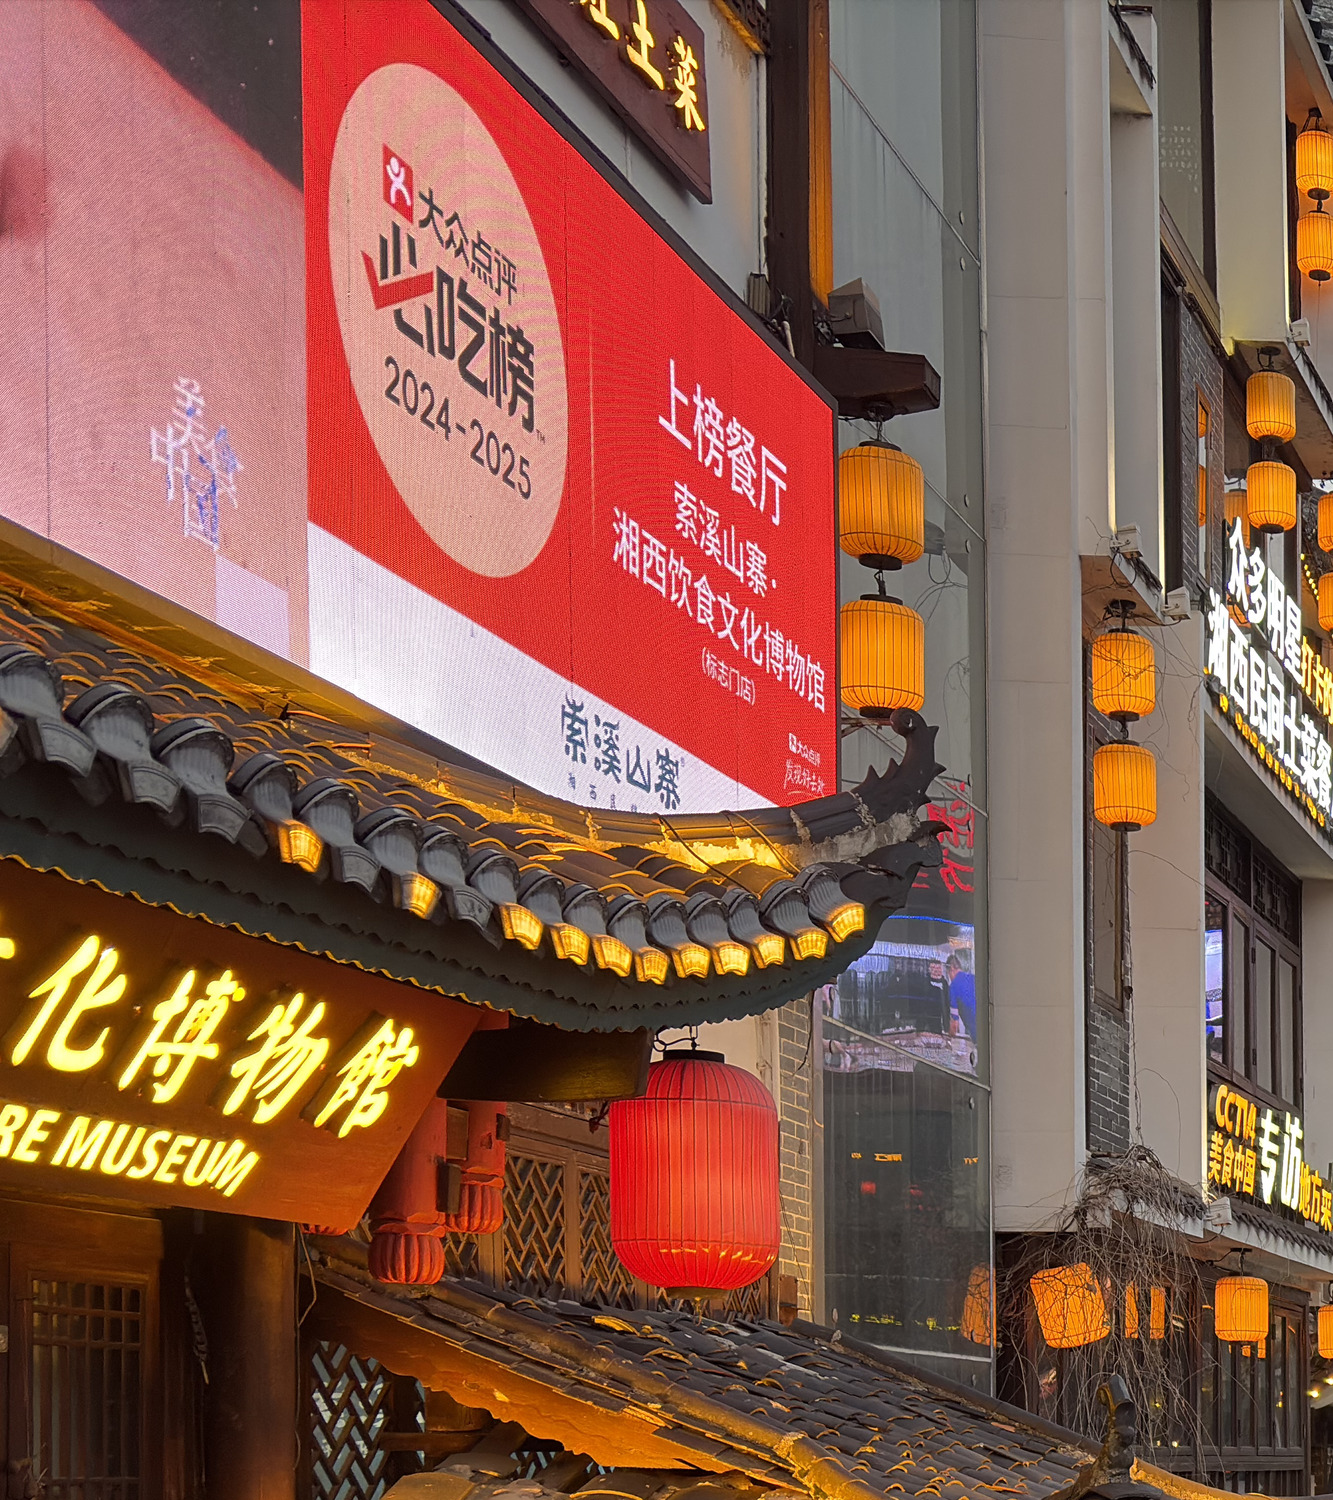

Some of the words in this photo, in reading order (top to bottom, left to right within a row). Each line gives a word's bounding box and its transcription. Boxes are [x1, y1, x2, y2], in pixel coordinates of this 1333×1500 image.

[580, 0, 706, 132] 土菜
[418, 187, 517, 305] 大众点评
[361, 221, 535, 434] 必吃榜
[384, 355, 532, 500] 2024-2025
[658, 358, 787, 527] 上榜餐厅
[612, 506, 826, 714] 湘西饮食文化博物馆
[561, 691, 681, 811] 索溪山寨
[797, 741, 821, 768] 大众点评
[0, 934, 421, 1139] 化博物館
[50, 1114, 261, 1198] MUSEUM
[1208, 1130, 1257, 1196] 美食中国
